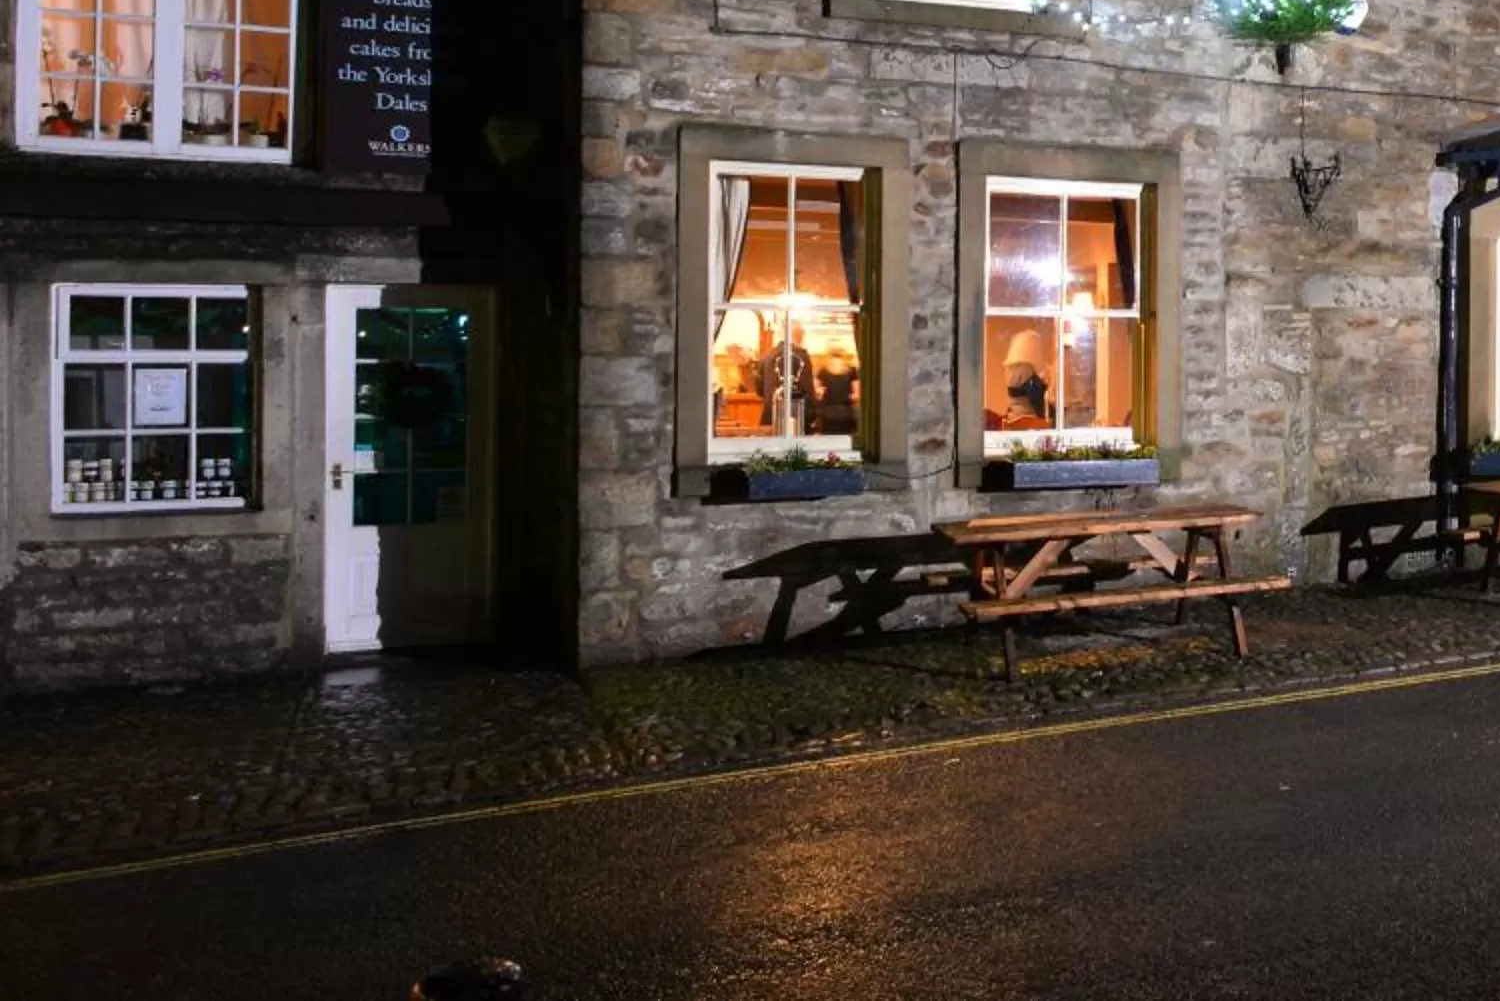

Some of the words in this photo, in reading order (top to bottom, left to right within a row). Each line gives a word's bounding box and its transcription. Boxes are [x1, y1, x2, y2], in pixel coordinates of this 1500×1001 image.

[341, 12, 377, 31] and
[349, 39, 401, 59] cakes
[338, 63, 368, 83] the
[375, 92, 428, 112] Dales
[368, 140, 432, 154] WALKERS
